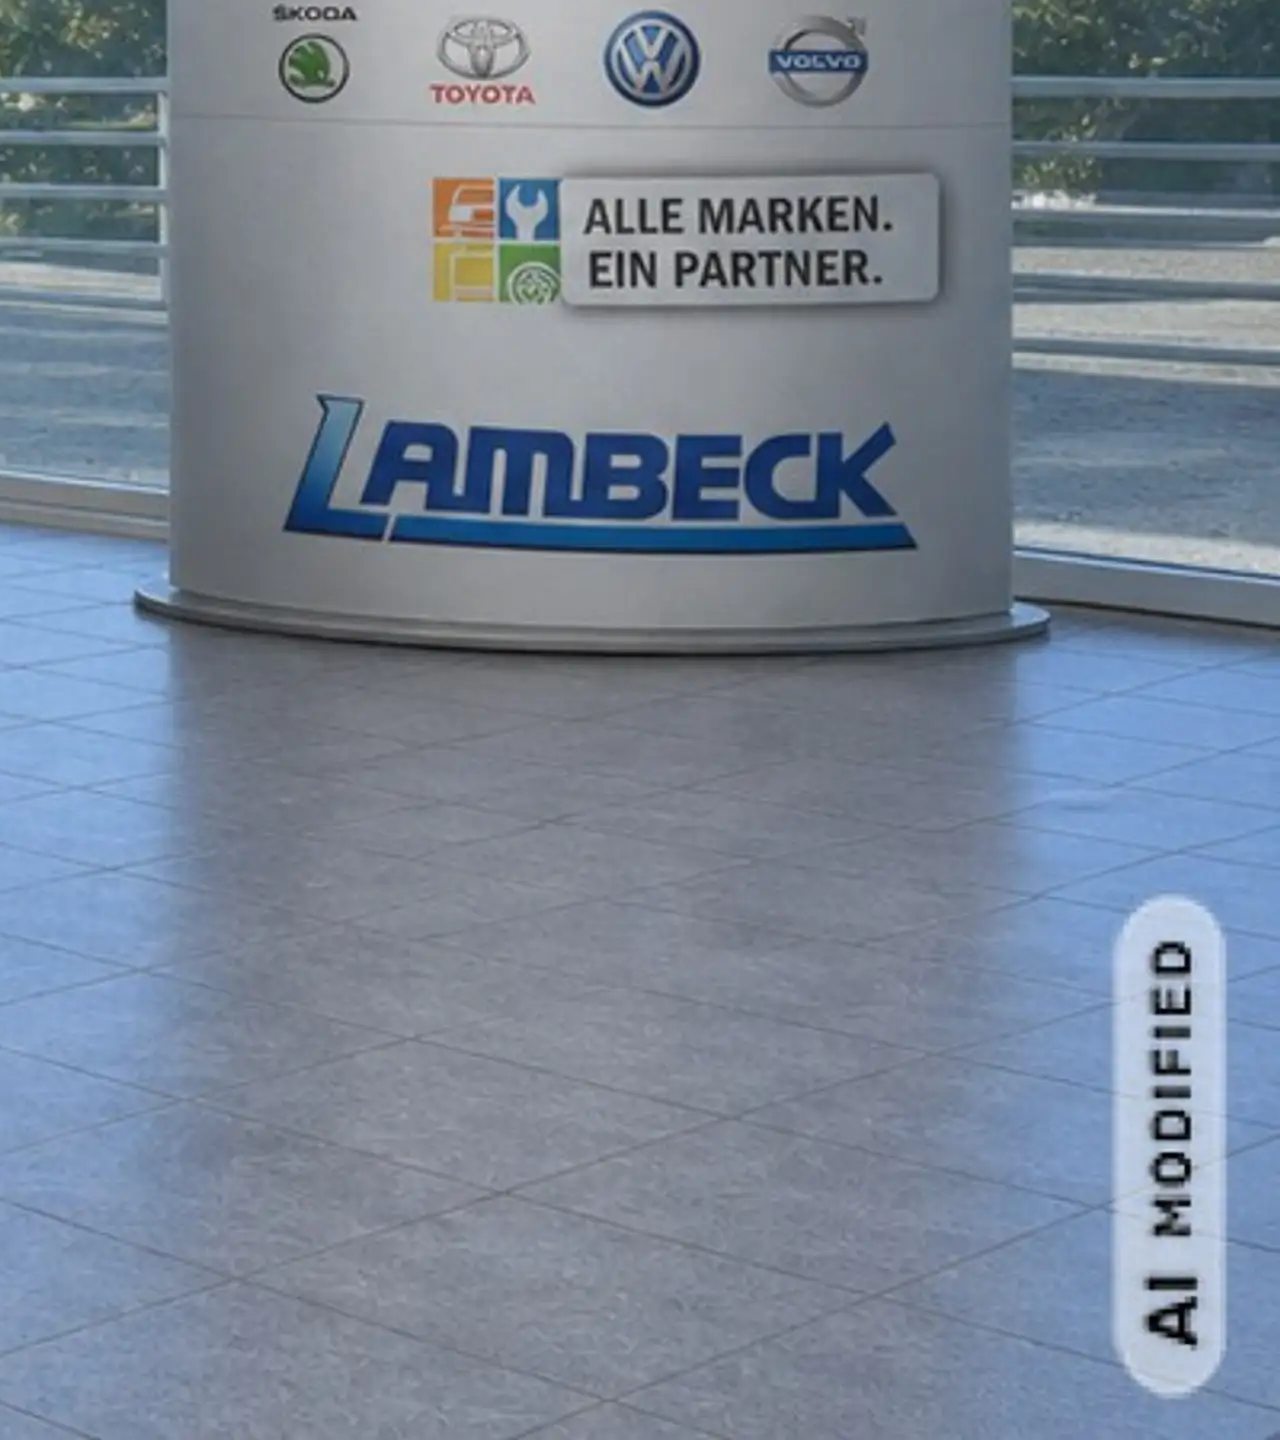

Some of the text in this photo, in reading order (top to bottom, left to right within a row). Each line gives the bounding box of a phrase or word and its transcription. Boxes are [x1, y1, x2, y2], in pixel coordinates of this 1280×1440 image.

[775, 53, 862, 70] VOLVO
[429, 84, 536, 105] TOYOTA
[584, 195, 893, 235] ALLE MARKEN.
[589, 249, 883, 289] EIN PARTNER.
[283, 394, 900, 544] LAMBECK
